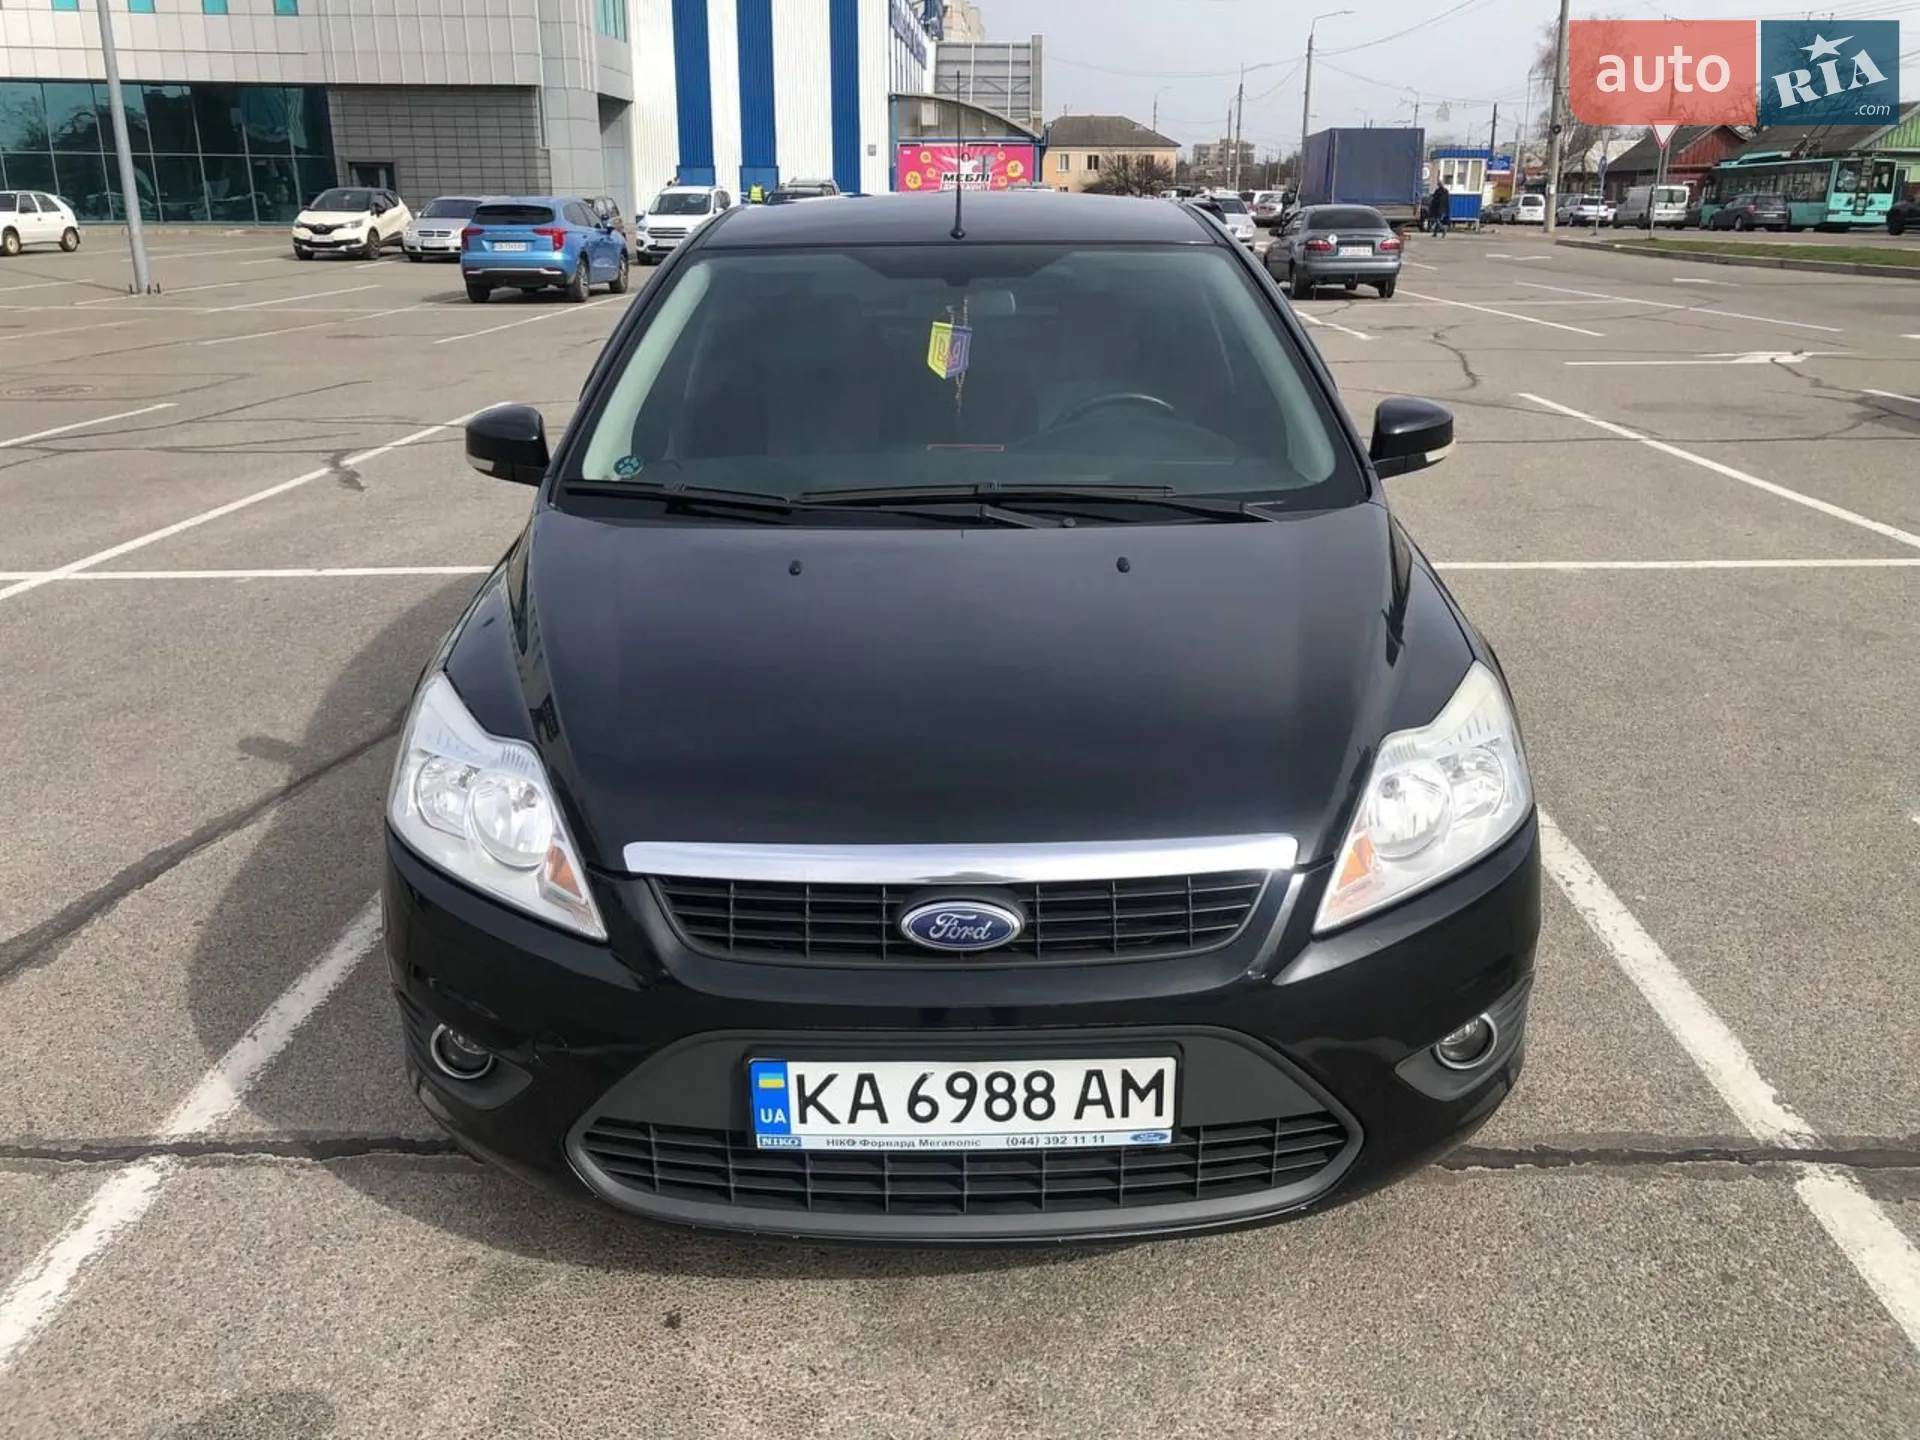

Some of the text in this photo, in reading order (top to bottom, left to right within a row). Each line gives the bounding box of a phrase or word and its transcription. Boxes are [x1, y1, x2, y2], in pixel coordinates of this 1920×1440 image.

[943, 173, 990, 182] МЕБЛІ
[929, 913, 993, 940] Ford
[796, 1068, 1166, 1124] KA 6988 AM
[760, 1108, 787, 1123] UA
[760, 1137, 800, 1147] NIKO
[919, 1138, 981, 1148] Мегаполіс
[1006, 1134, 1105, 1147] (044) 392 11 11
